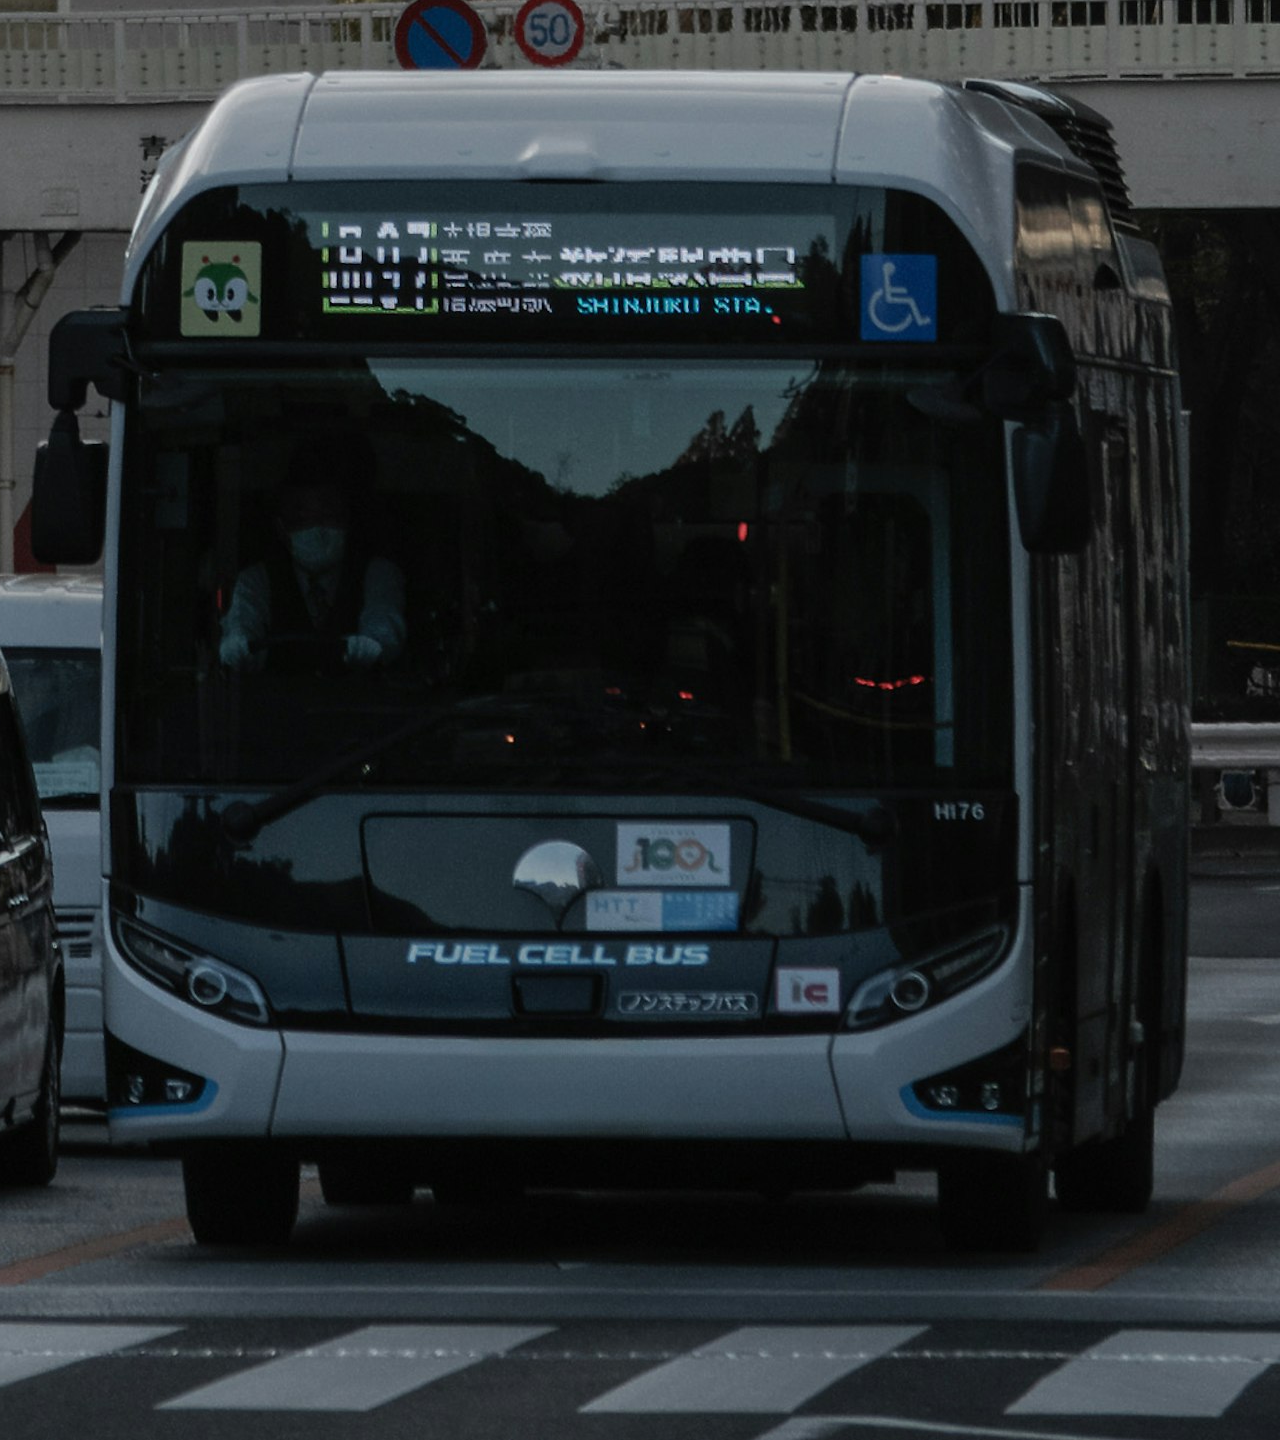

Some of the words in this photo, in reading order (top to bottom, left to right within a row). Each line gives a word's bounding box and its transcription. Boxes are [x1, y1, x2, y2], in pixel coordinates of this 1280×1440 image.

[531, 13, 569, 47] 50
[407, 944, 511, 966] FUEL
[517, 944, 616, 966] CELL
[625, 944, 710, 966] BUS
[626, 993, 750, 1012] ノンステップバス
